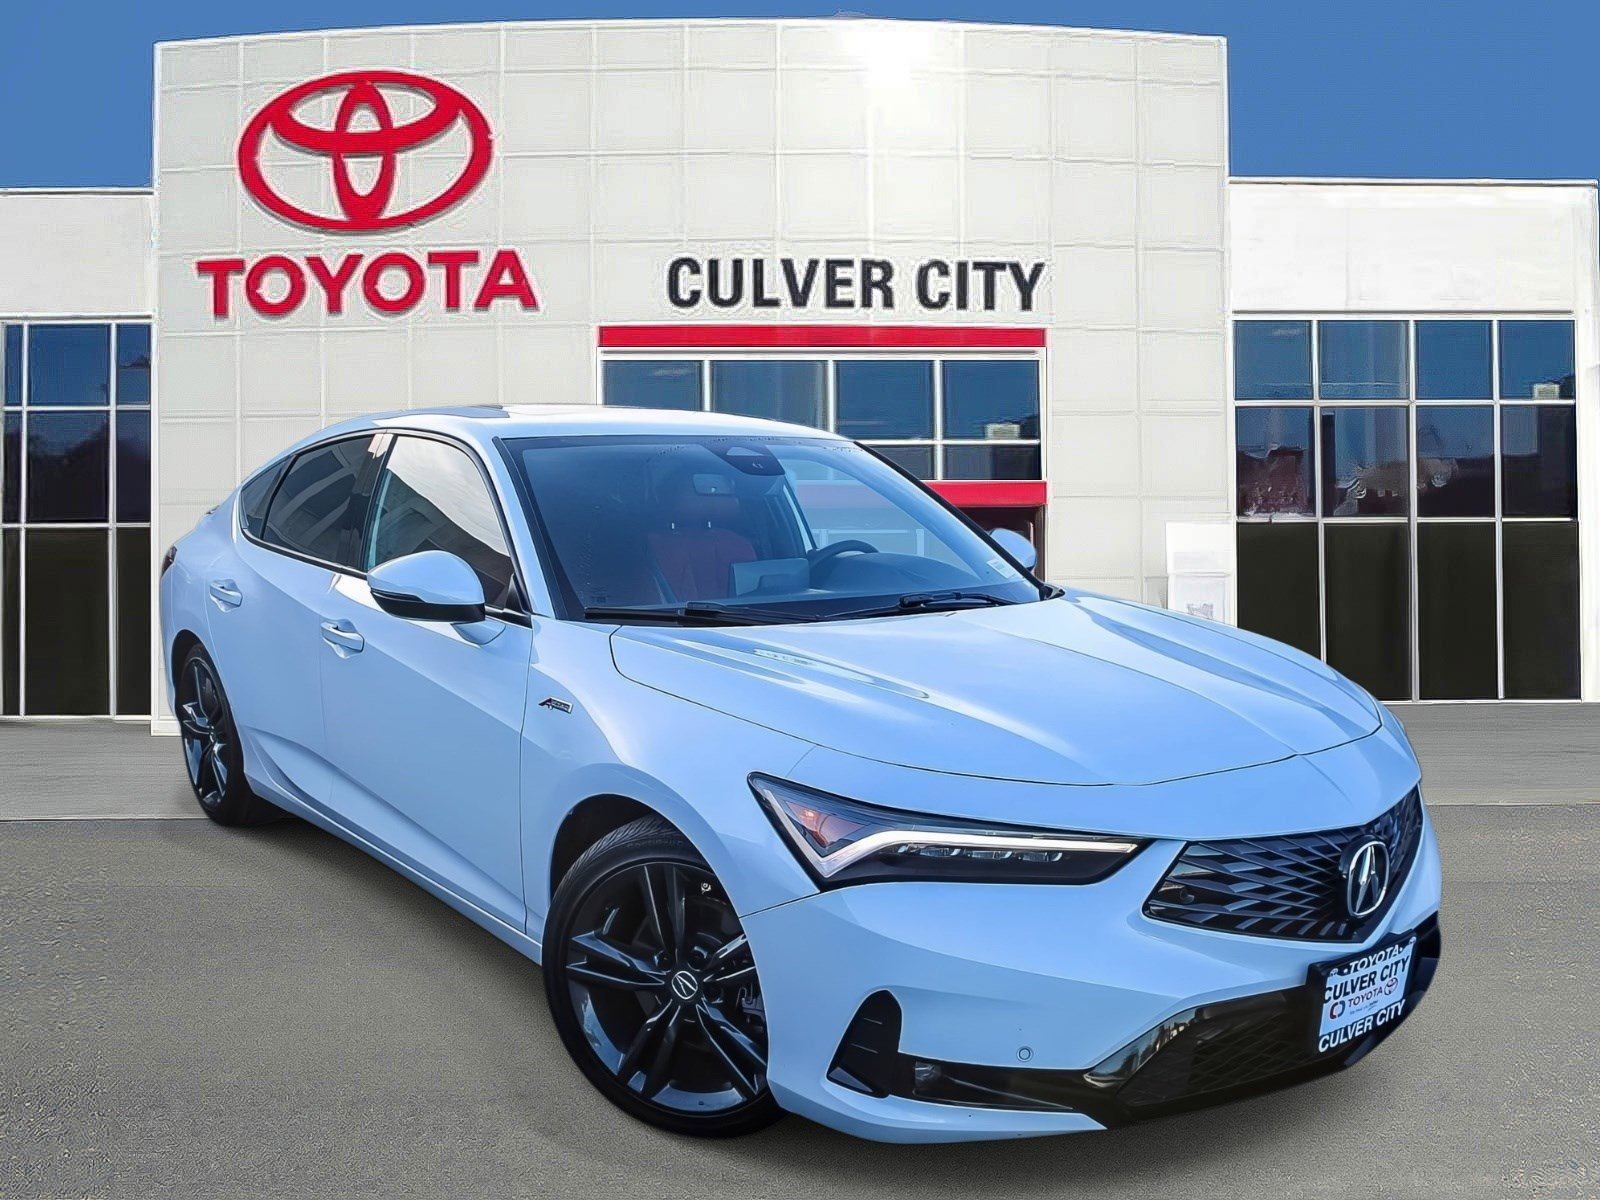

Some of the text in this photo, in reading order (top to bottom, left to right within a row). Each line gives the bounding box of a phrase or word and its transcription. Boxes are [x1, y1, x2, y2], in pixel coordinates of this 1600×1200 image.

[196, 250, 539, 318] TOYOTA
[667, 257, 1045, 311] CULVER CITY
[1325, 955, 1410, 1004] CULVER CITY
[1349, 944, 1399, 974] TOYOTA
[1348, 986, 1383, 1008] TOYOTA
[1318, 1015, 1373, 1053] CULVER
[1376, 998, 1406, 1026] CITY
